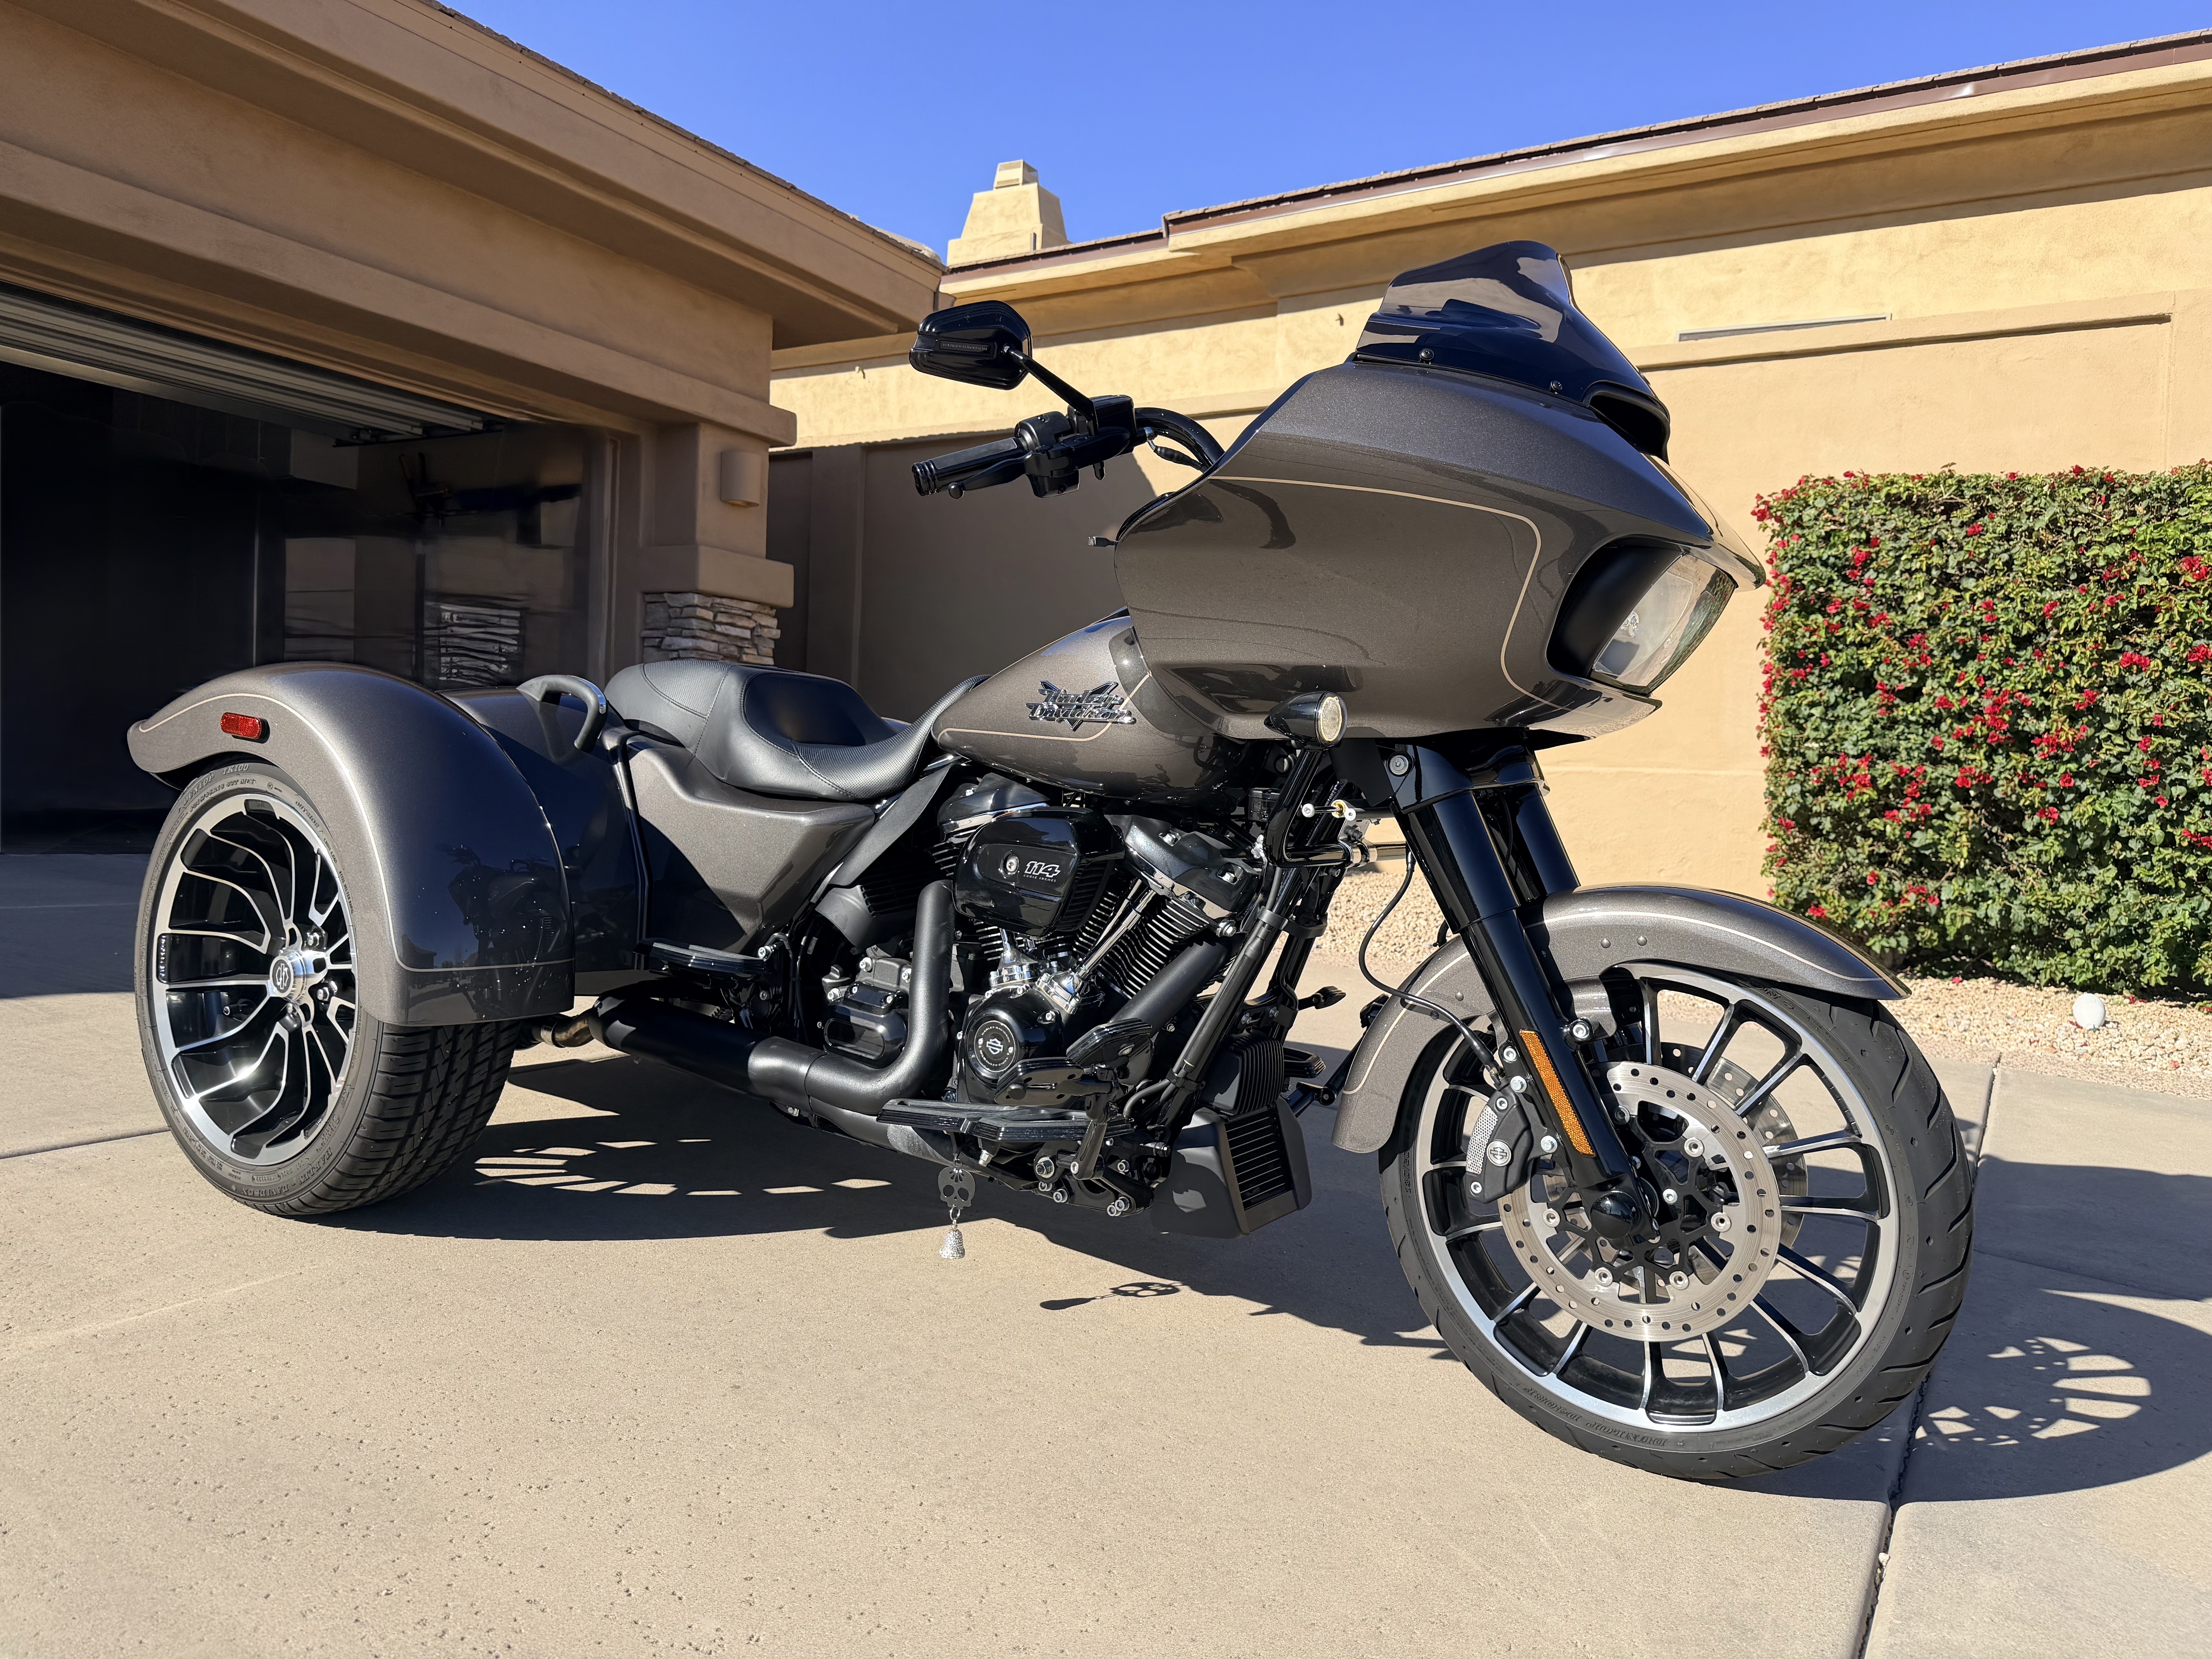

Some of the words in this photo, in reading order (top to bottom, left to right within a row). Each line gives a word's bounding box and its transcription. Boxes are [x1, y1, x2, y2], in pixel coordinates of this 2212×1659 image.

[1038, 689, 1123, 709] Harley
[1025, 703, 1136, 724] Davidson
[184, 772, 215, 805] DUNLOP
[223, 764, 249, 775] TK100
[1024, 860, 1061, 878] 114
[982, 1026, 1010, 1043] HARLEY-DAVIDSON
[242, 1184, 289, 1197] DAVIDSON
[1523, 1387, 1583, 1422] D408F
[1587, 1421, 1668, 1446] DUNLOP
